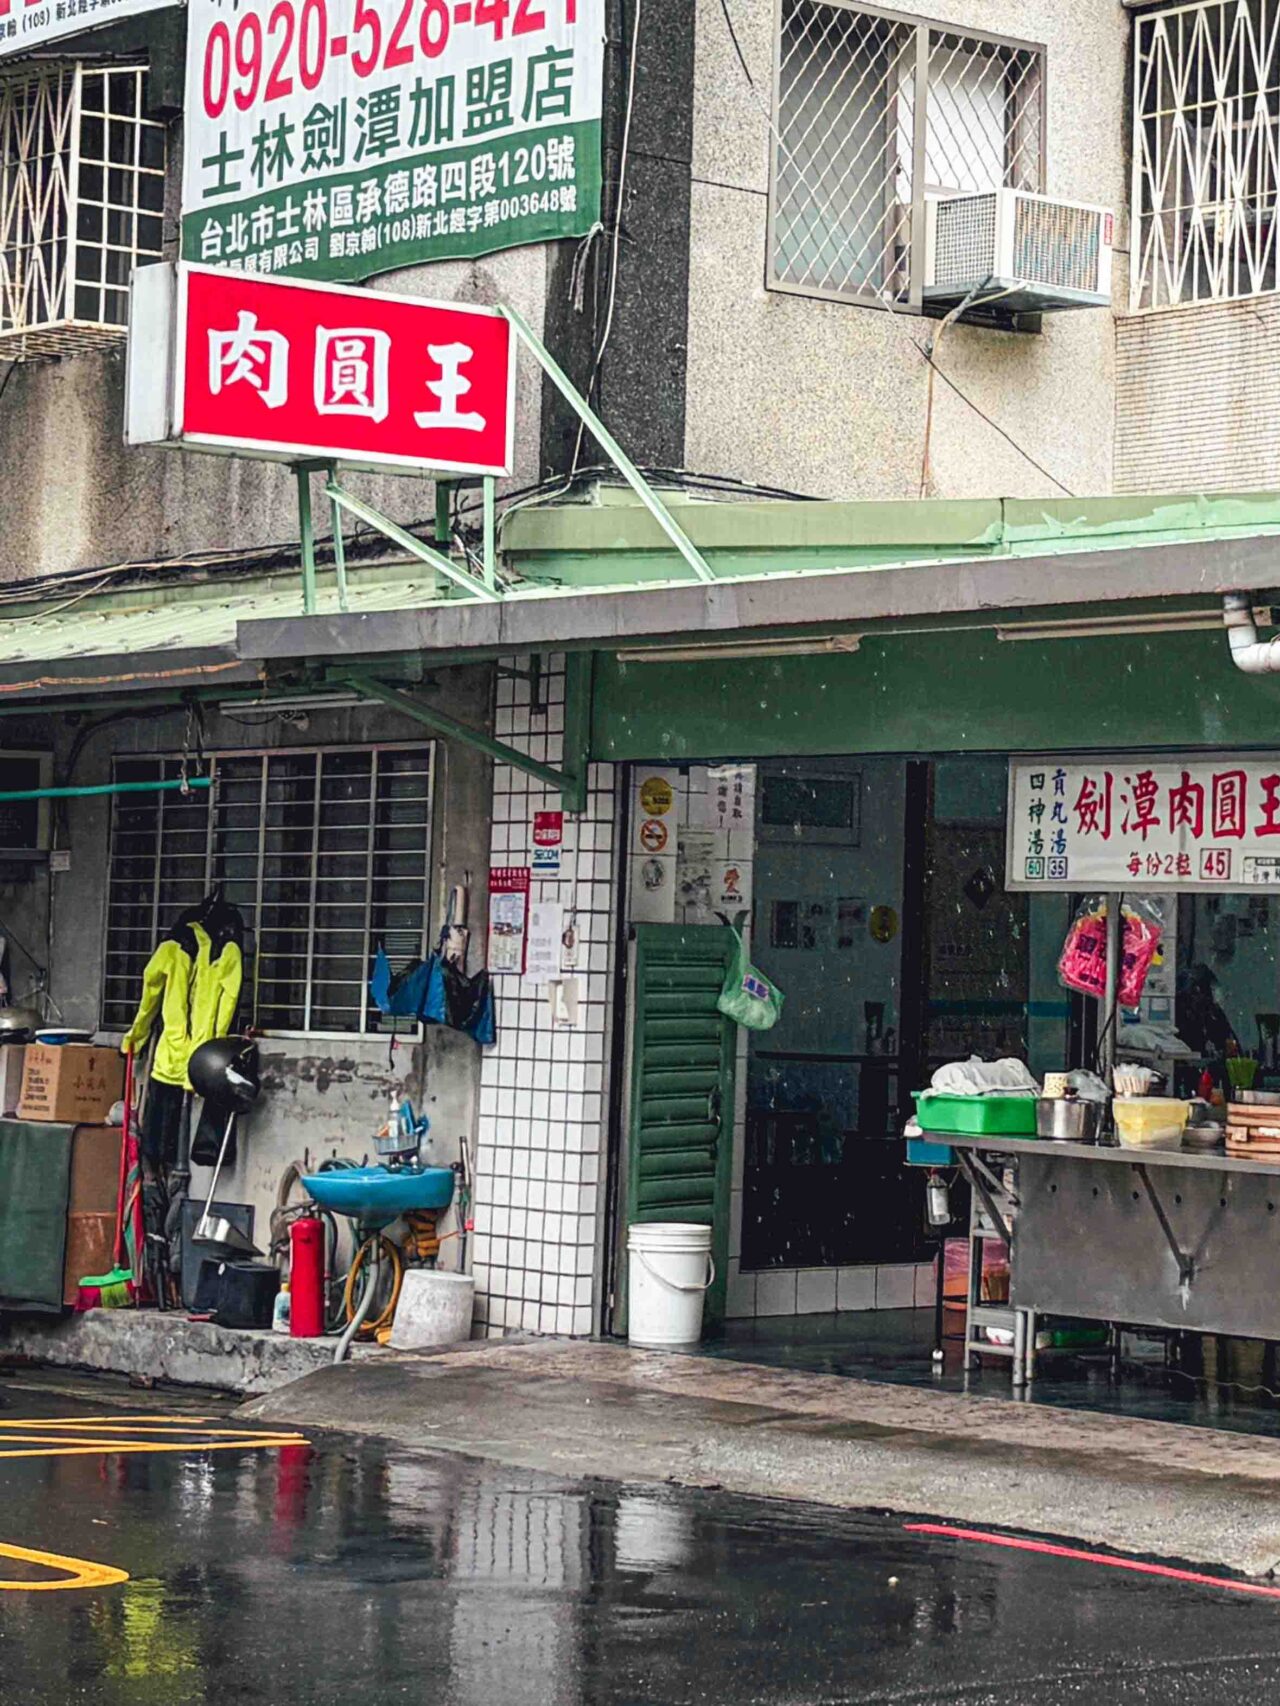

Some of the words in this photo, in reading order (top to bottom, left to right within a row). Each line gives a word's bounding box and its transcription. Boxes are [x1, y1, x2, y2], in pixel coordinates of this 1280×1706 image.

[203, 0, 577, 119] 0920-528-
[202, 45, 575, 198] 士林劍潭加盟店
[201, 135, 576, 259] 台北市士林區承德路四段120號
[206, 309, 487, 433] 肉圓王
[1027, 772, 1045, 855] 四神湯
[1050, 768, 1068, 855] 貢丸湯
[1050, 860, 1065, 876] 35
[1126, 851, 1192, 877] 每份2粒
[1203, 851, 1226, 877] 45
